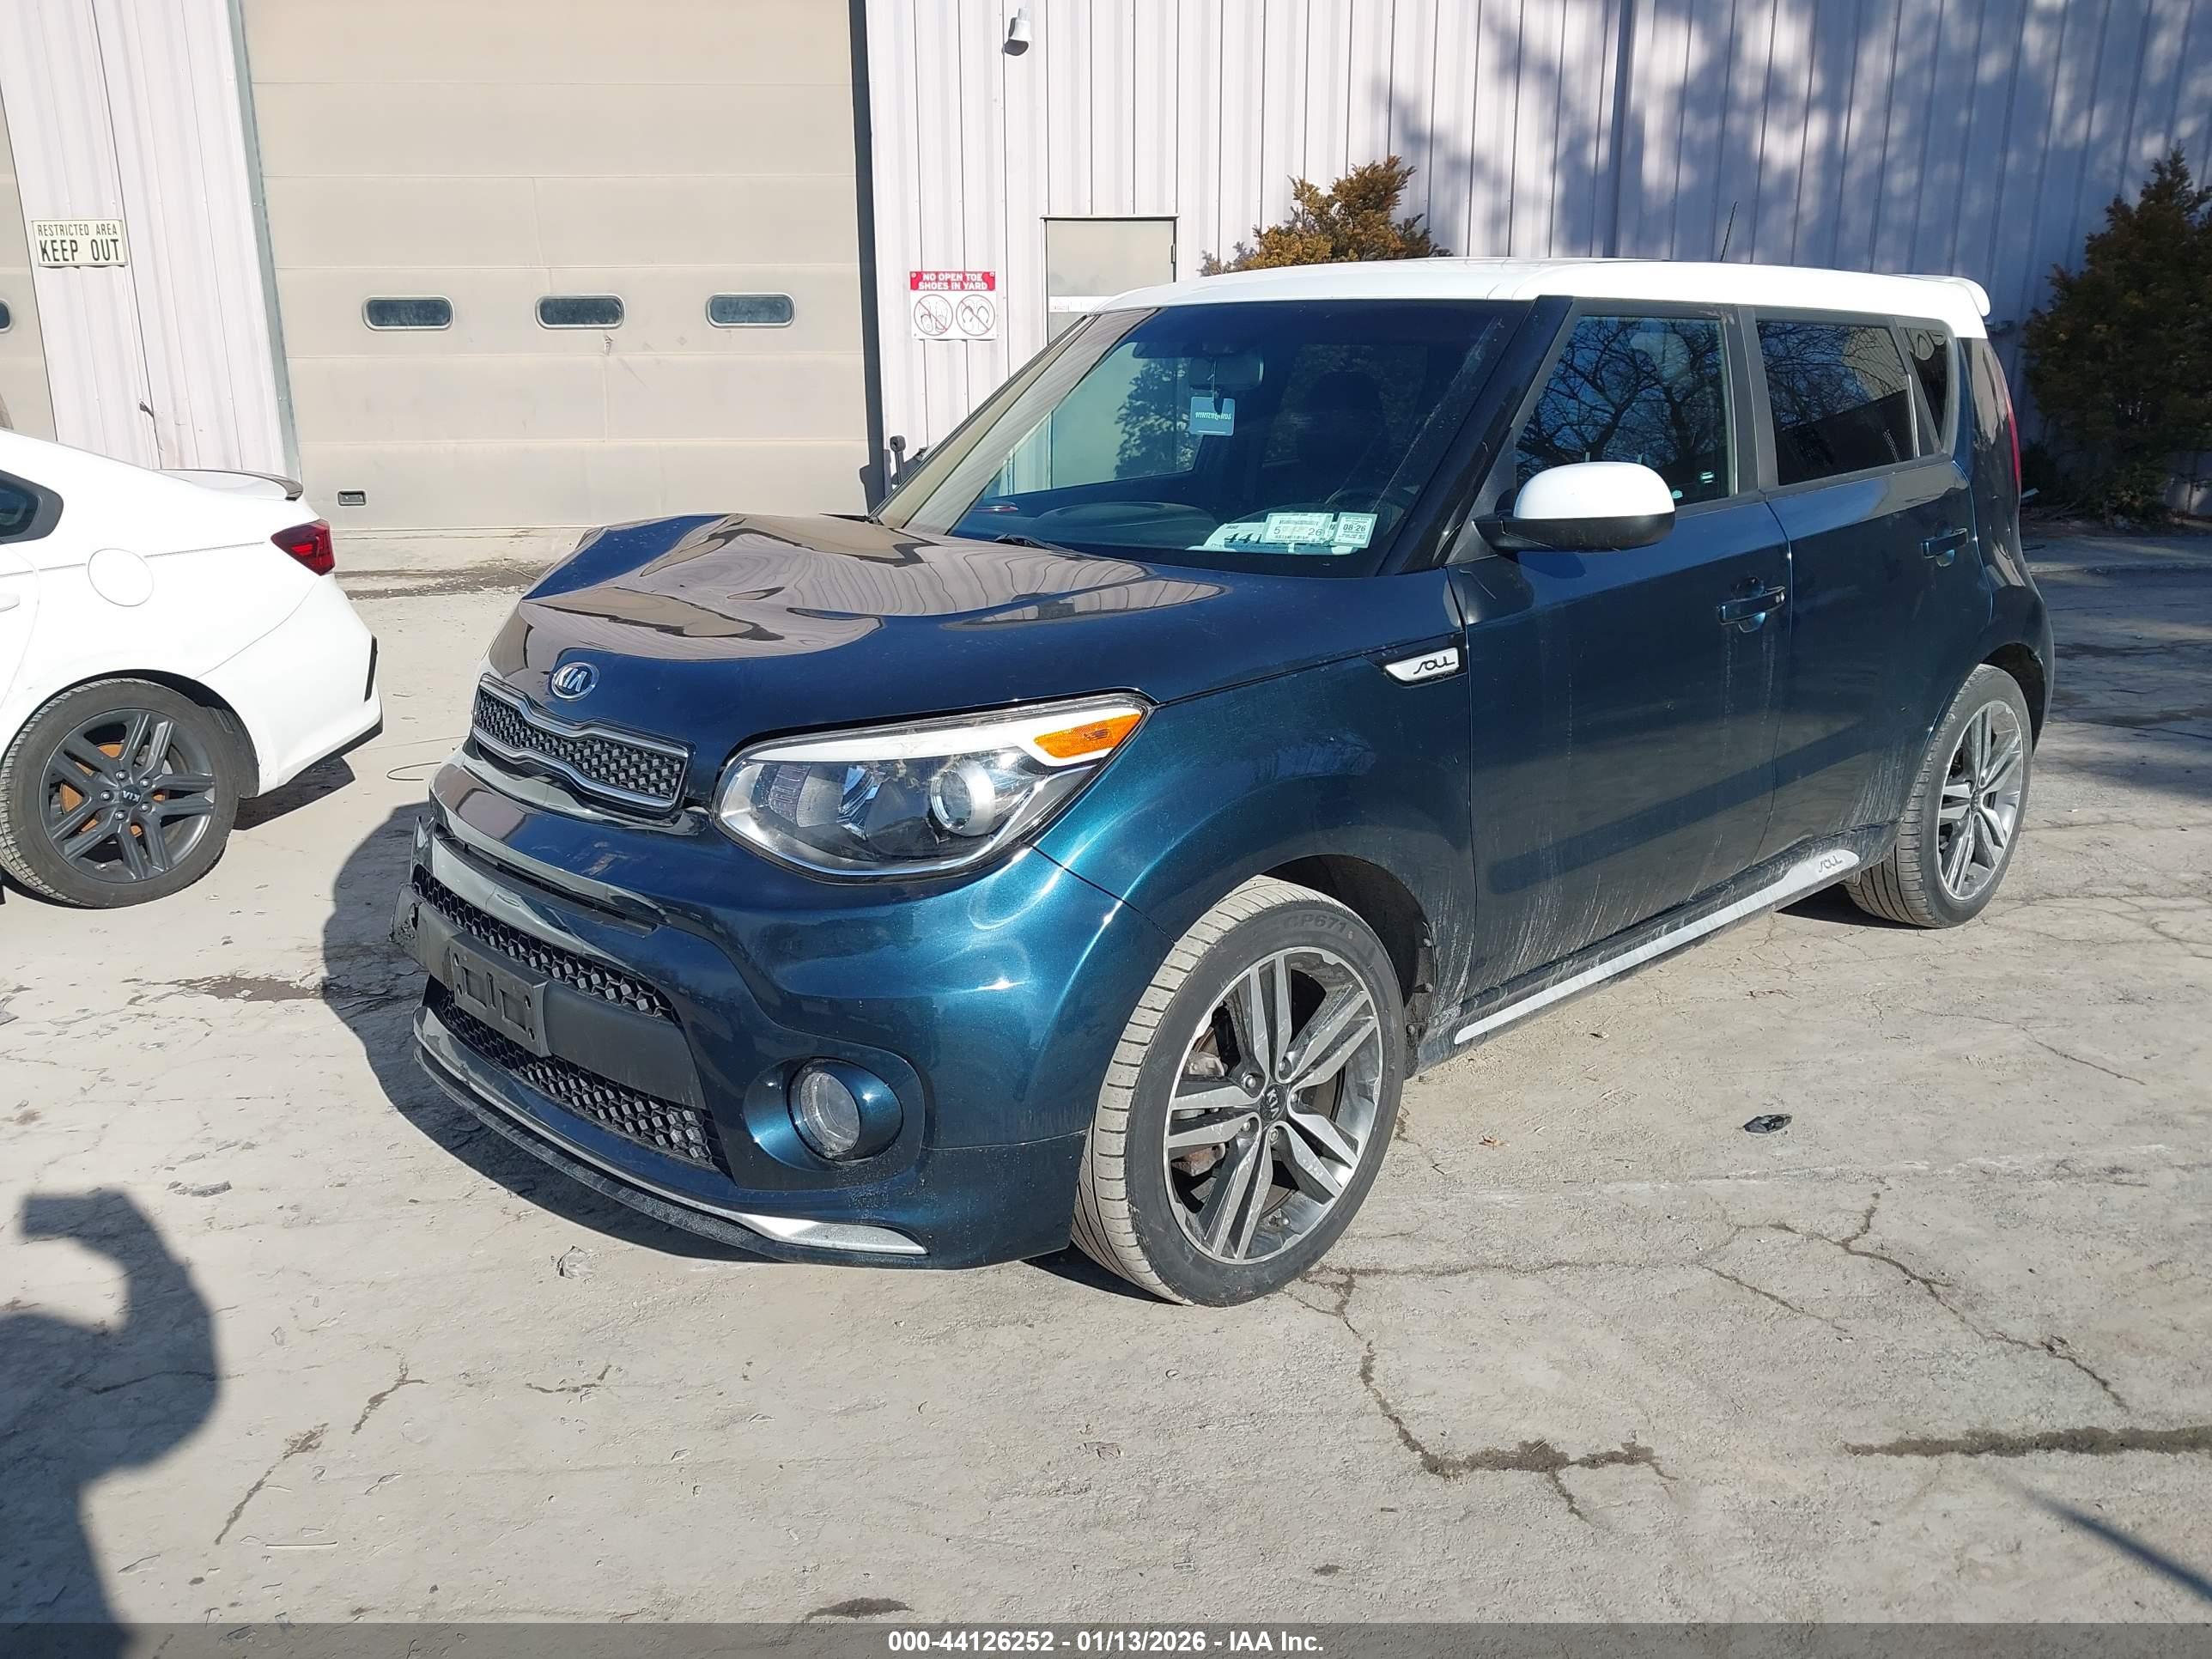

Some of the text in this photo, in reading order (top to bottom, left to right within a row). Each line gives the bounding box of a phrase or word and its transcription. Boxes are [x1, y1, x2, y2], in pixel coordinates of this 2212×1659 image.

[37, 223, 118, 236] RESTRICTED AREA
[39, 239, 119, 262] KEEP OUT
[922, 273, 983, 282] NO OPEN TOE
[918, 282, 988, 290] SHOES IN YARD
[1308, 527, 1322, 537] 26
[555, 666, 588, 692] KIA
[1267, 1088, 1279, 1119] KIA
